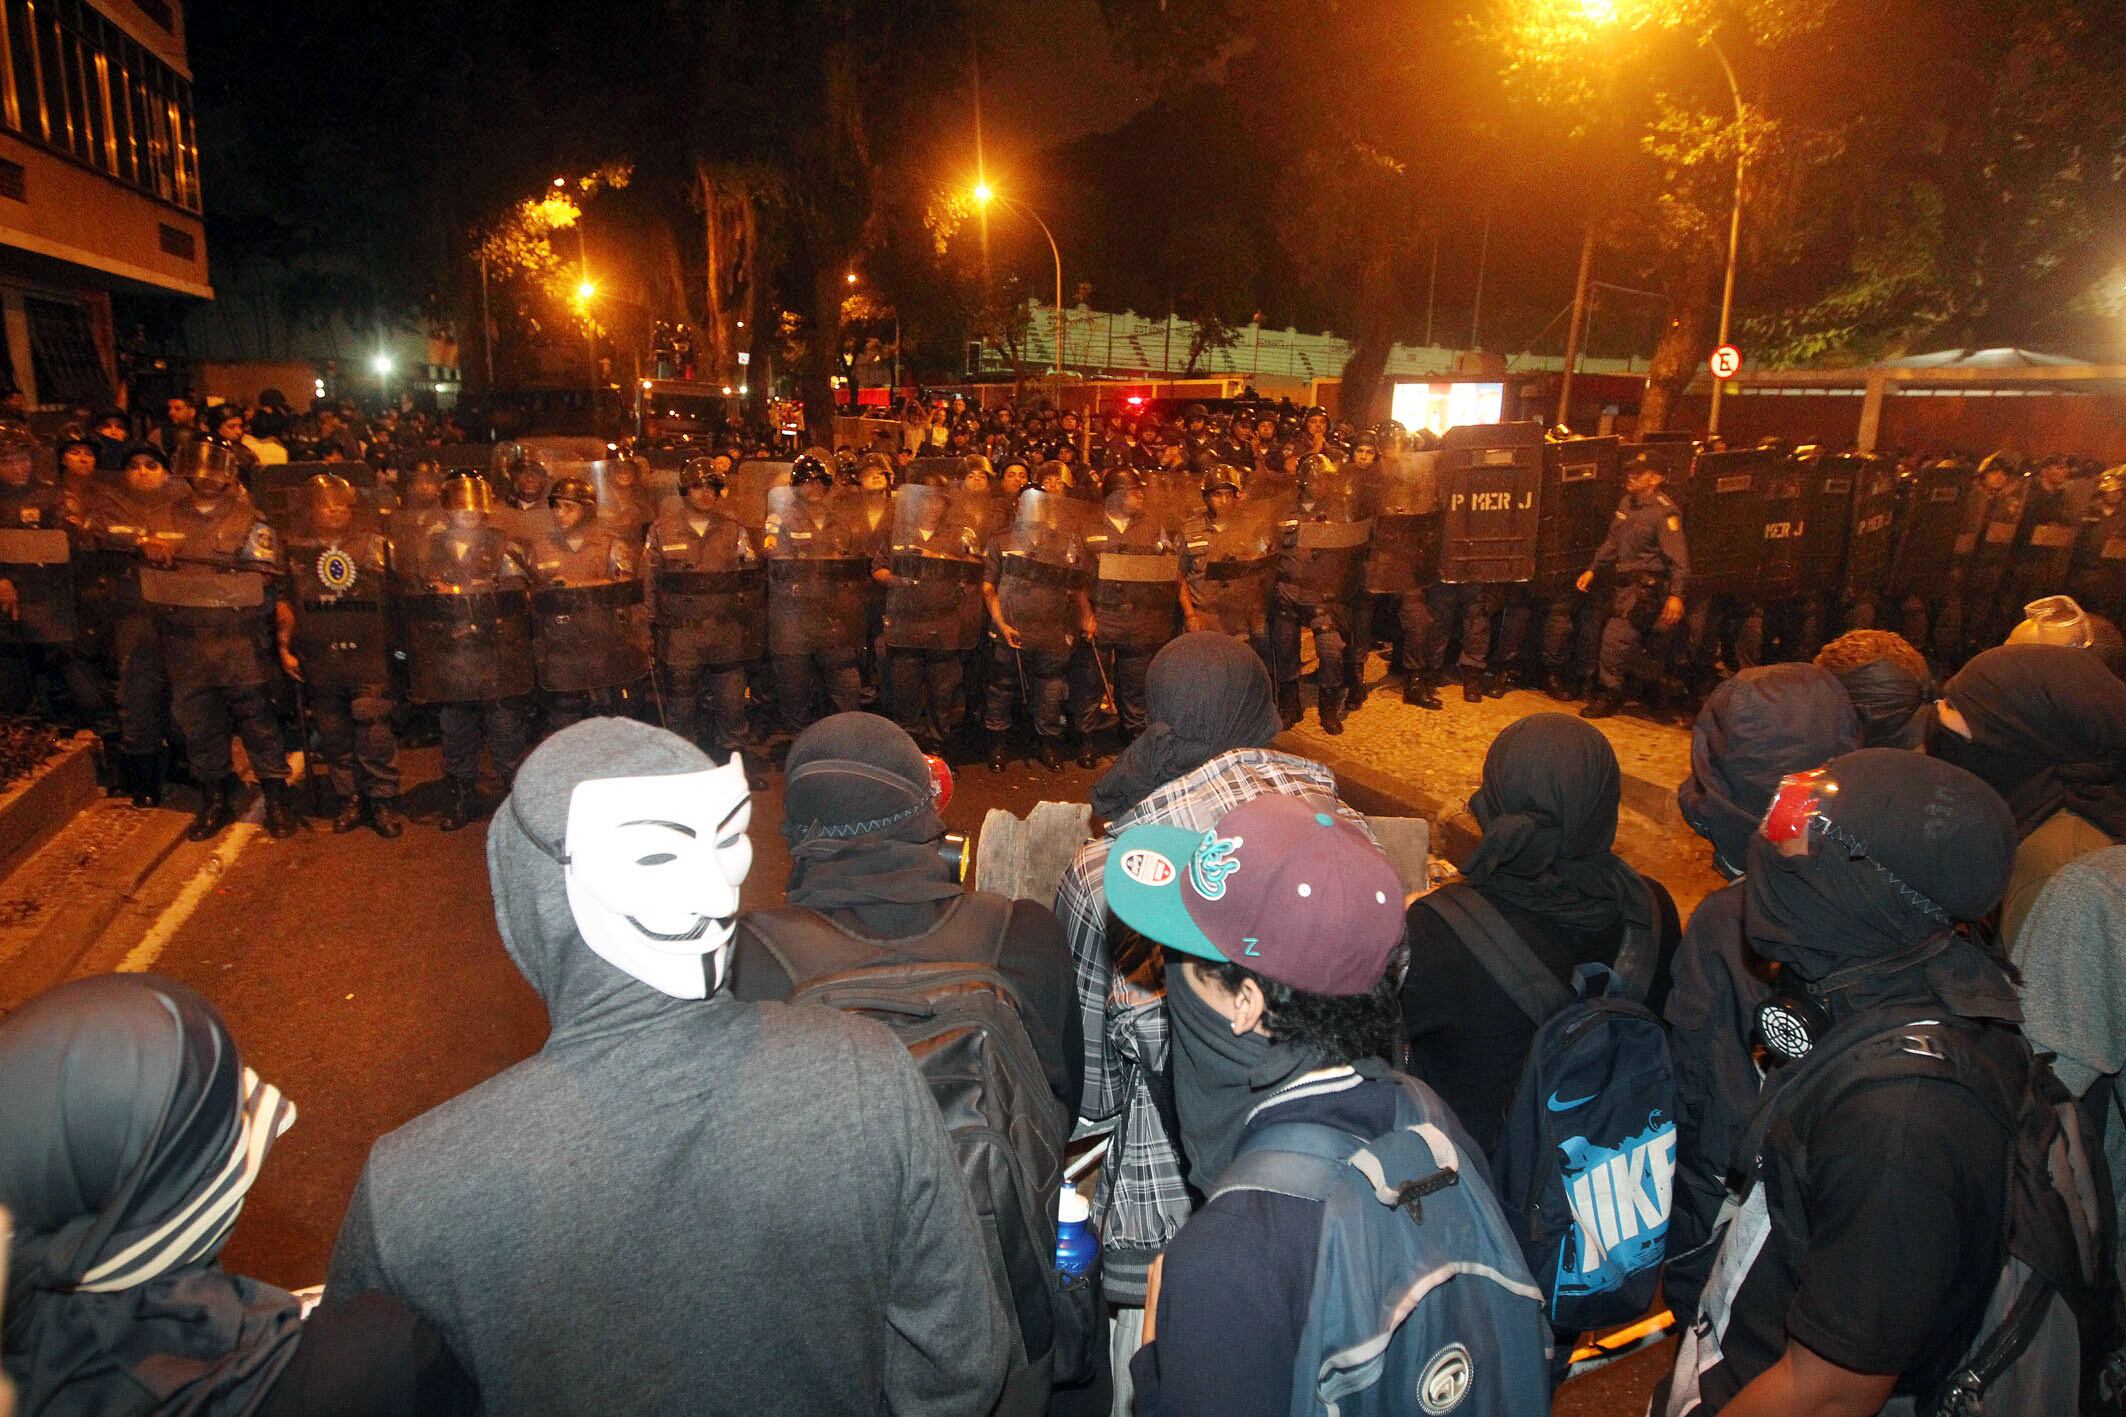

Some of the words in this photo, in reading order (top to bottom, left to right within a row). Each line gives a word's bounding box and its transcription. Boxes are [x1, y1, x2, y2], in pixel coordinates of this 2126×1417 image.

[1720, 353, 1731, 371] E
[1451, 493, 1465, 511] P
[1517, 491, 1533, 510] J
[1240, 937, 1260, 957] Z
